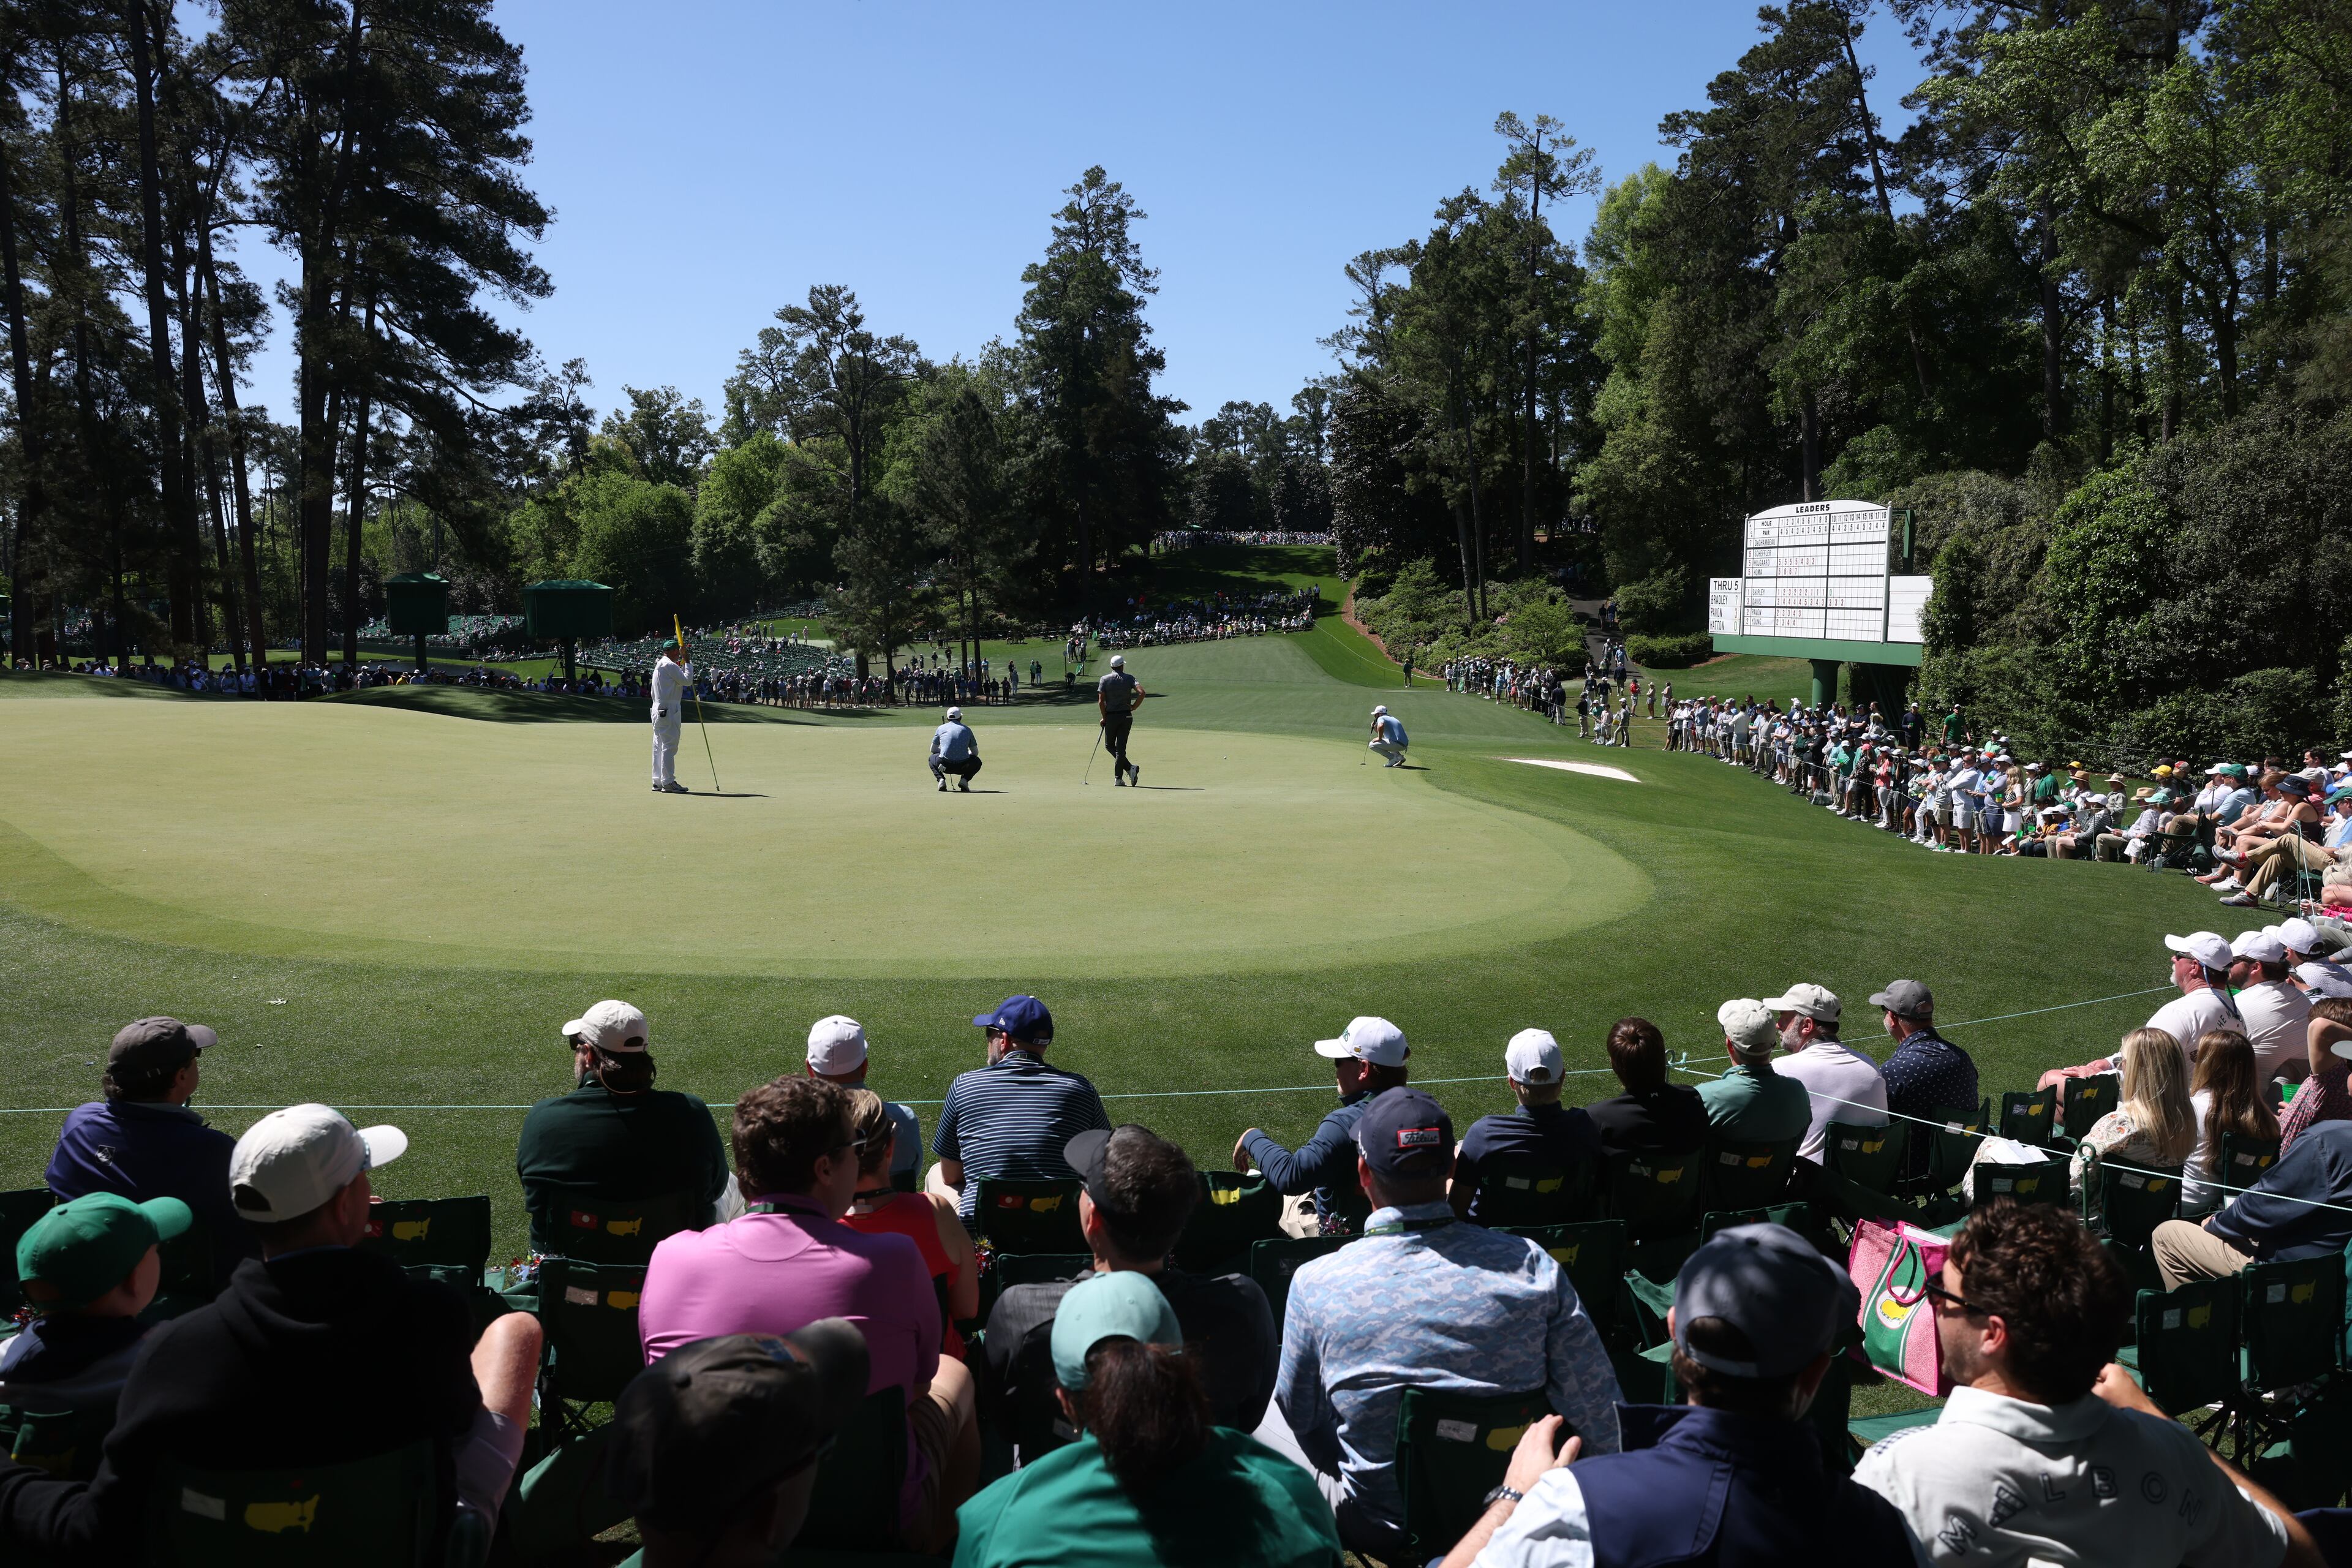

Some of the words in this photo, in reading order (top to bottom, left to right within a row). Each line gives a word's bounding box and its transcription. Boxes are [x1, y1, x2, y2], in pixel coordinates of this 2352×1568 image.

[1796, 504, 1830, 513] LEADERS
[1713, 581, 1732, 590] THRU
[1734, 581, 1738, 591] 5
[1711, 595, 1728, 605] BRADLEY
[1735, 595, 1738, 605] 7
[1711, 608, 1722, 617] PAVON
[1735, 608, 1737, 618] 3
[1710, 621, 1724, 630] HATTON
[1734, 621, 1737, 631] 0
[2215, 1014, 2226, 1030] HE
[1403, 1132, 1438, 1145] Titleist
